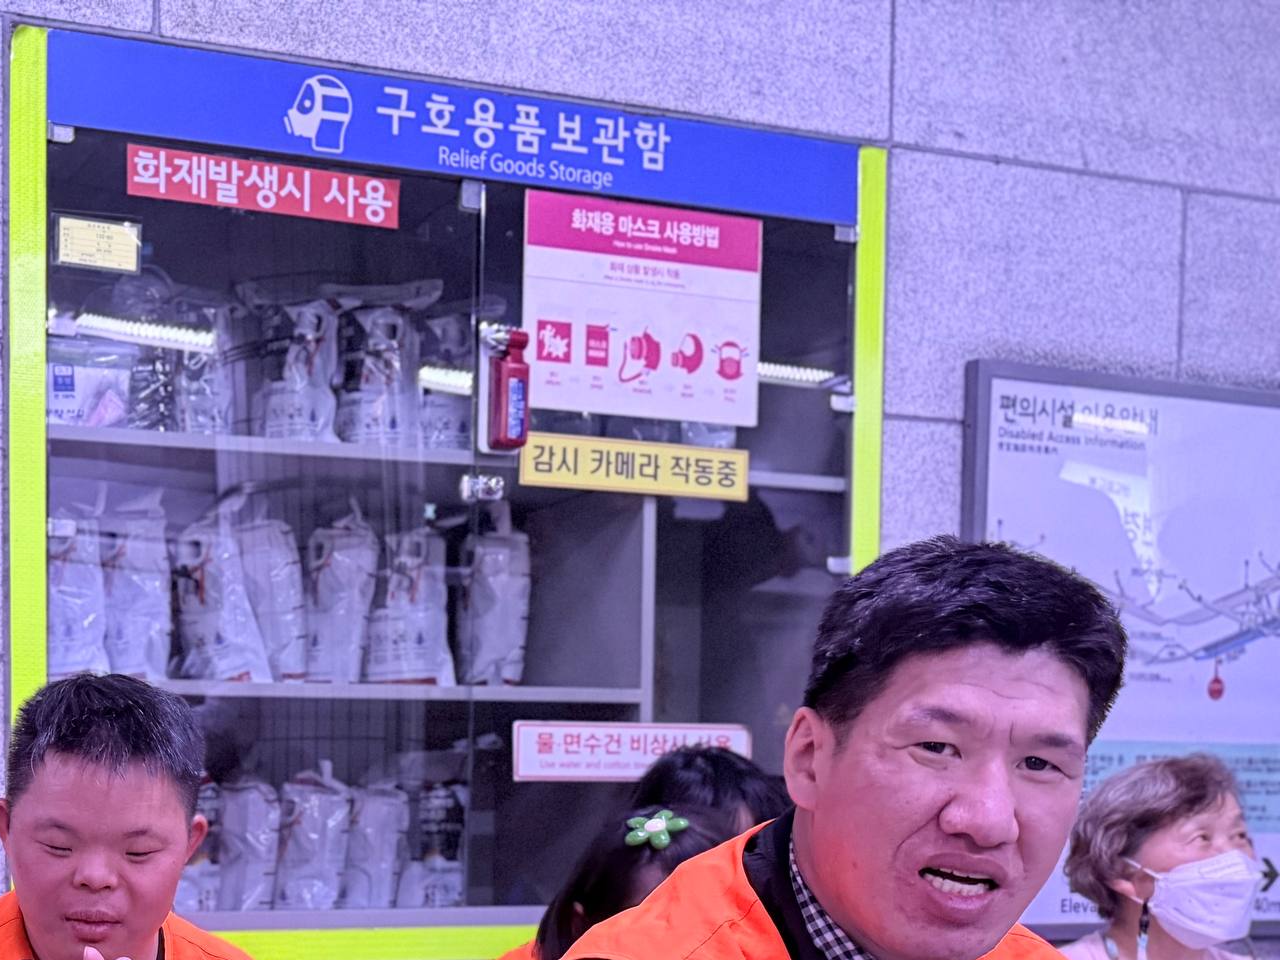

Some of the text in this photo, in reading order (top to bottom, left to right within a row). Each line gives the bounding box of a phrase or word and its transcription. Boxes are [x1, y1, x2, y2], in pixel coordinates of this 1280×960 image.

[376, 85, 671, 171] 구호용품보관함
[133, 150, 392, 223] 화재발생시 사용
[438, 146, 613, 190] Relief Goods Storage
[571, 208, 720, 248] 화재용 마스크 사용방법
[999, 394, 1075, 428] 편의시설
[532, 444, 738, 488] 감시 카메라 작동중
